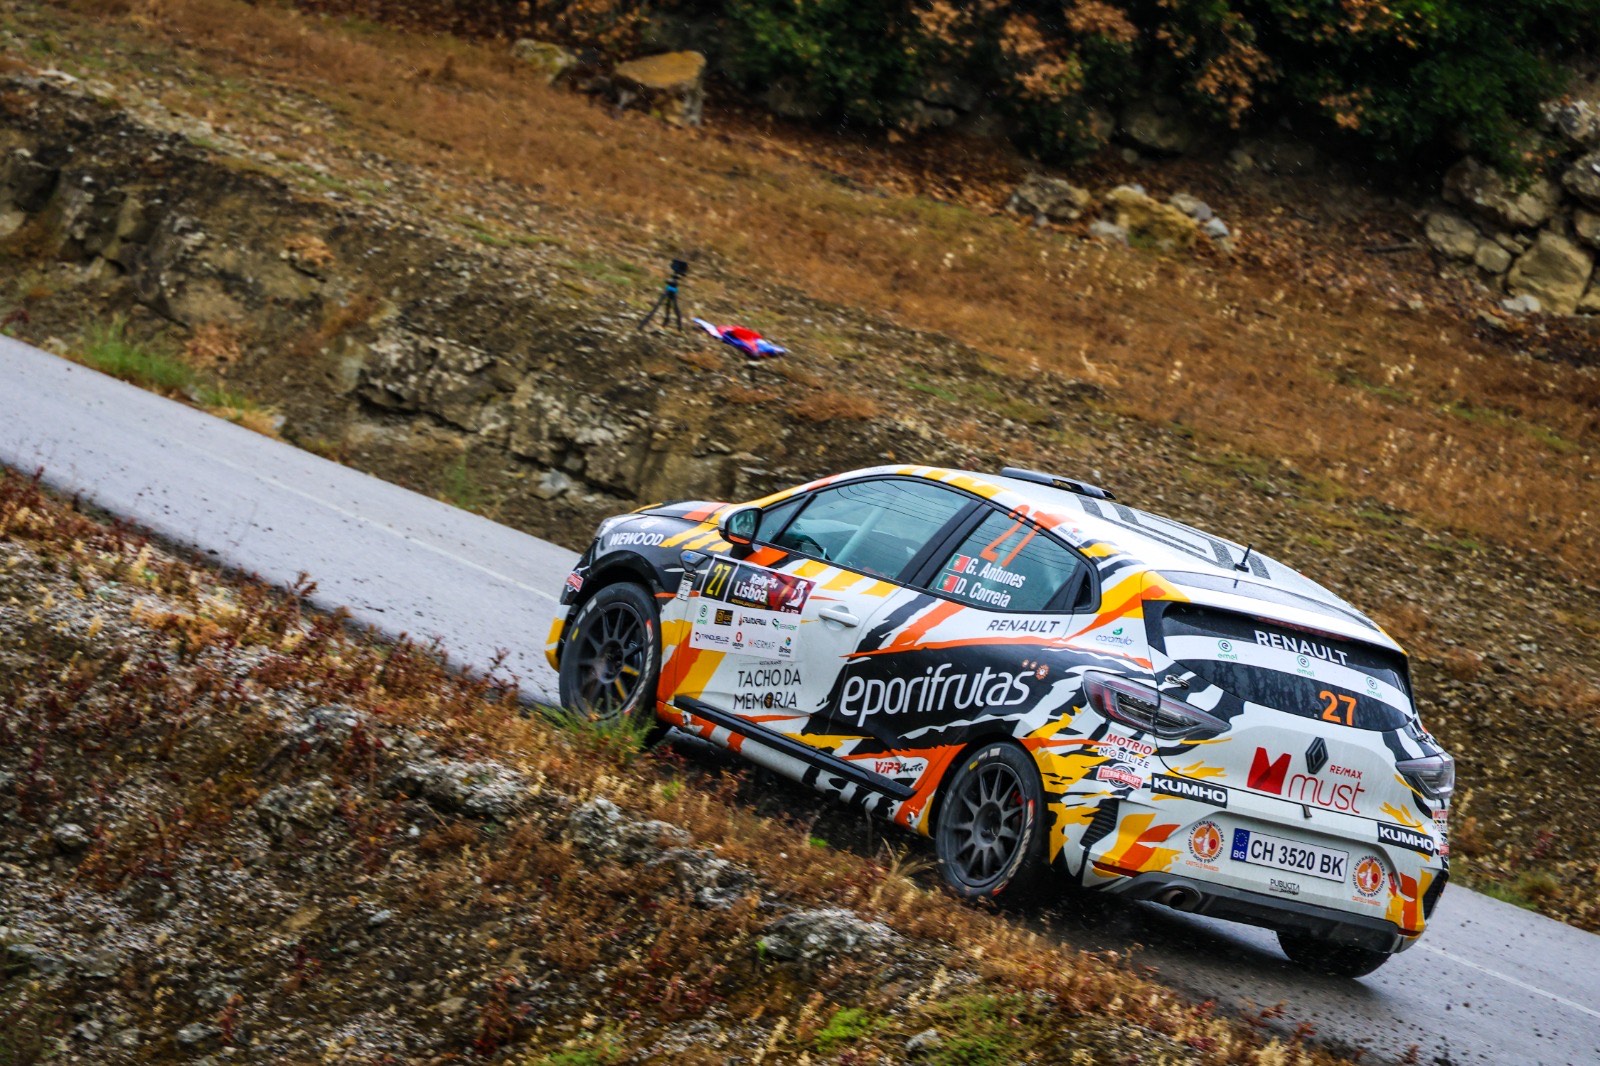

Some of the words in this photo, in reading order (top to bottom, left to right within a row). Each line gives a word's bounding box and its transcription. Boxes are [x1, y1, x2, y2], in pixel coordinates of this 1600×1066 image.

[609, 533, 664, 546] WEWOOD
[705, 563, 732, 596] 27
[965, 558, 977, 575] G.
[981, 565, 1026, 589] Antunes
[733, 581, 768, 603] Lisboa
[954, 579, 966, 595] D.
[969, 583, 1011, 608] Correia
[986, 620, 1060, 633] RENAULT
[1254, 630, 1348, 666] RENAULT
[738, 669, 781, 687] TACHO
[784, 669, 801, 685] DA
[733, 692, 797, 709] MEMORIA
[839, 663, 1035, 727] eporifrutas
[1319, 690, 1357, 726] 27
[1106, 734, 1152, 755] MOTRIO
[1100, 747, 1150, 769] MOBILIZE
[1330, 765, 1363, 780] RE/MAX
[1154, 778, 1226, 802] KUMHO
[1289, 774, 1365, 814] must
[1380, 827, 1433, 851] KUMHO
[1233, 850, 1245, 858] BG
[1251, 840, 1275, 861] CH
[1278, 846, 1315, 870] 3520
[1320, 854, 1344, 876] BK
